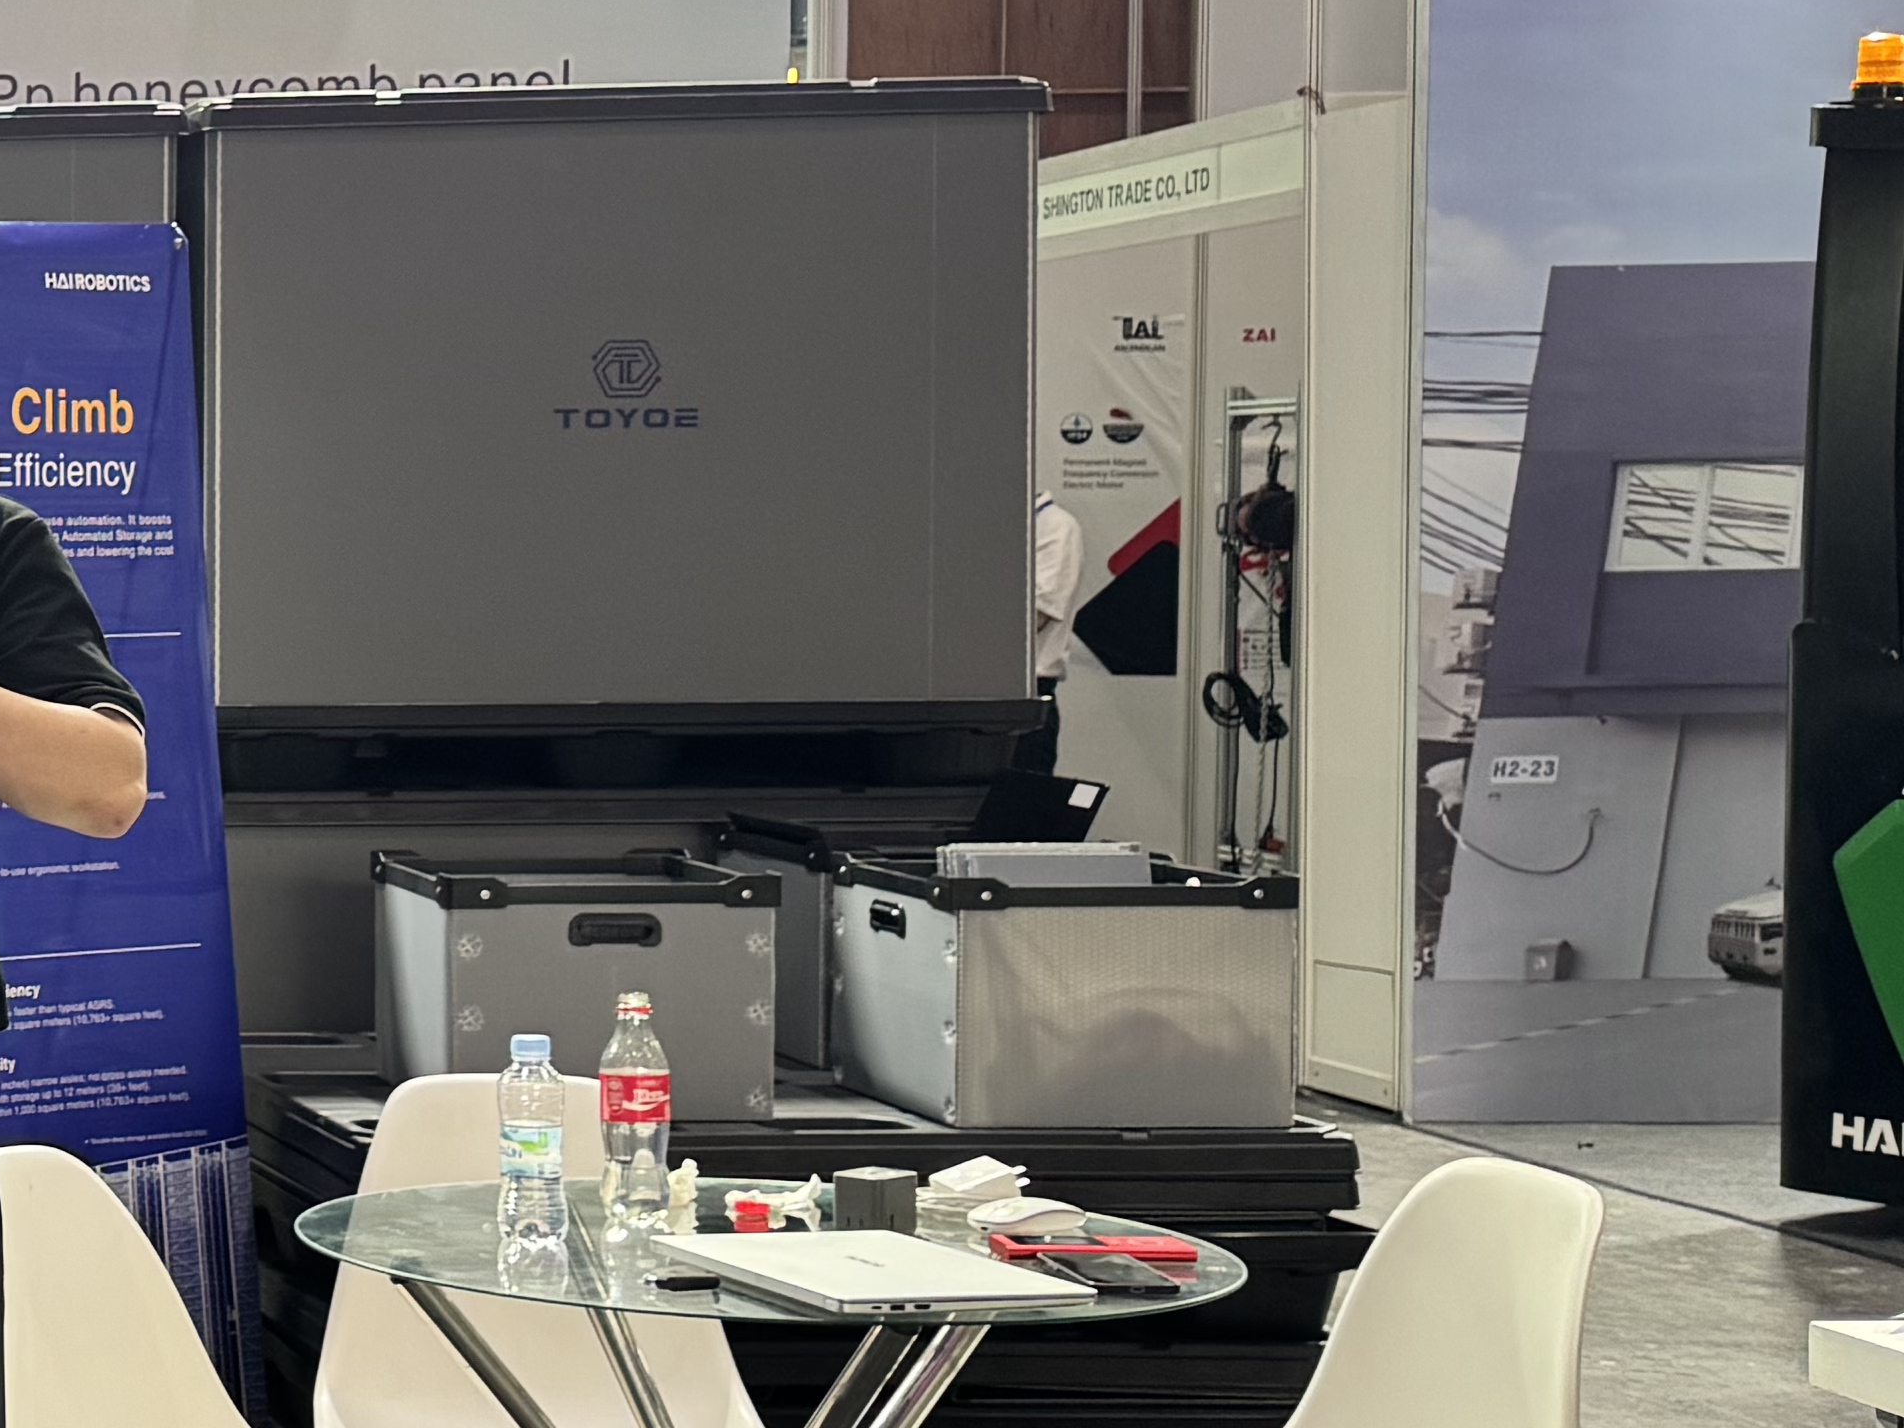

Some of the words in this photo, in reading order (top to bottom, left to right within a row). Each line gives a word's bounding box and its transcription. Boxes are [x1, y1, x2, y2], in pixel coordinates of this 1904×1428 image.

[1107, 178, 1153, 209] TRADE
[1184, 167, 1211, 194] LTD
[11, 386, 136, 435] Climb
[553, 408, 699, 429] TOYOE
[1493, 759, 1555, 778] H2-23
[1831, 1112, 1904, 1158] HA
